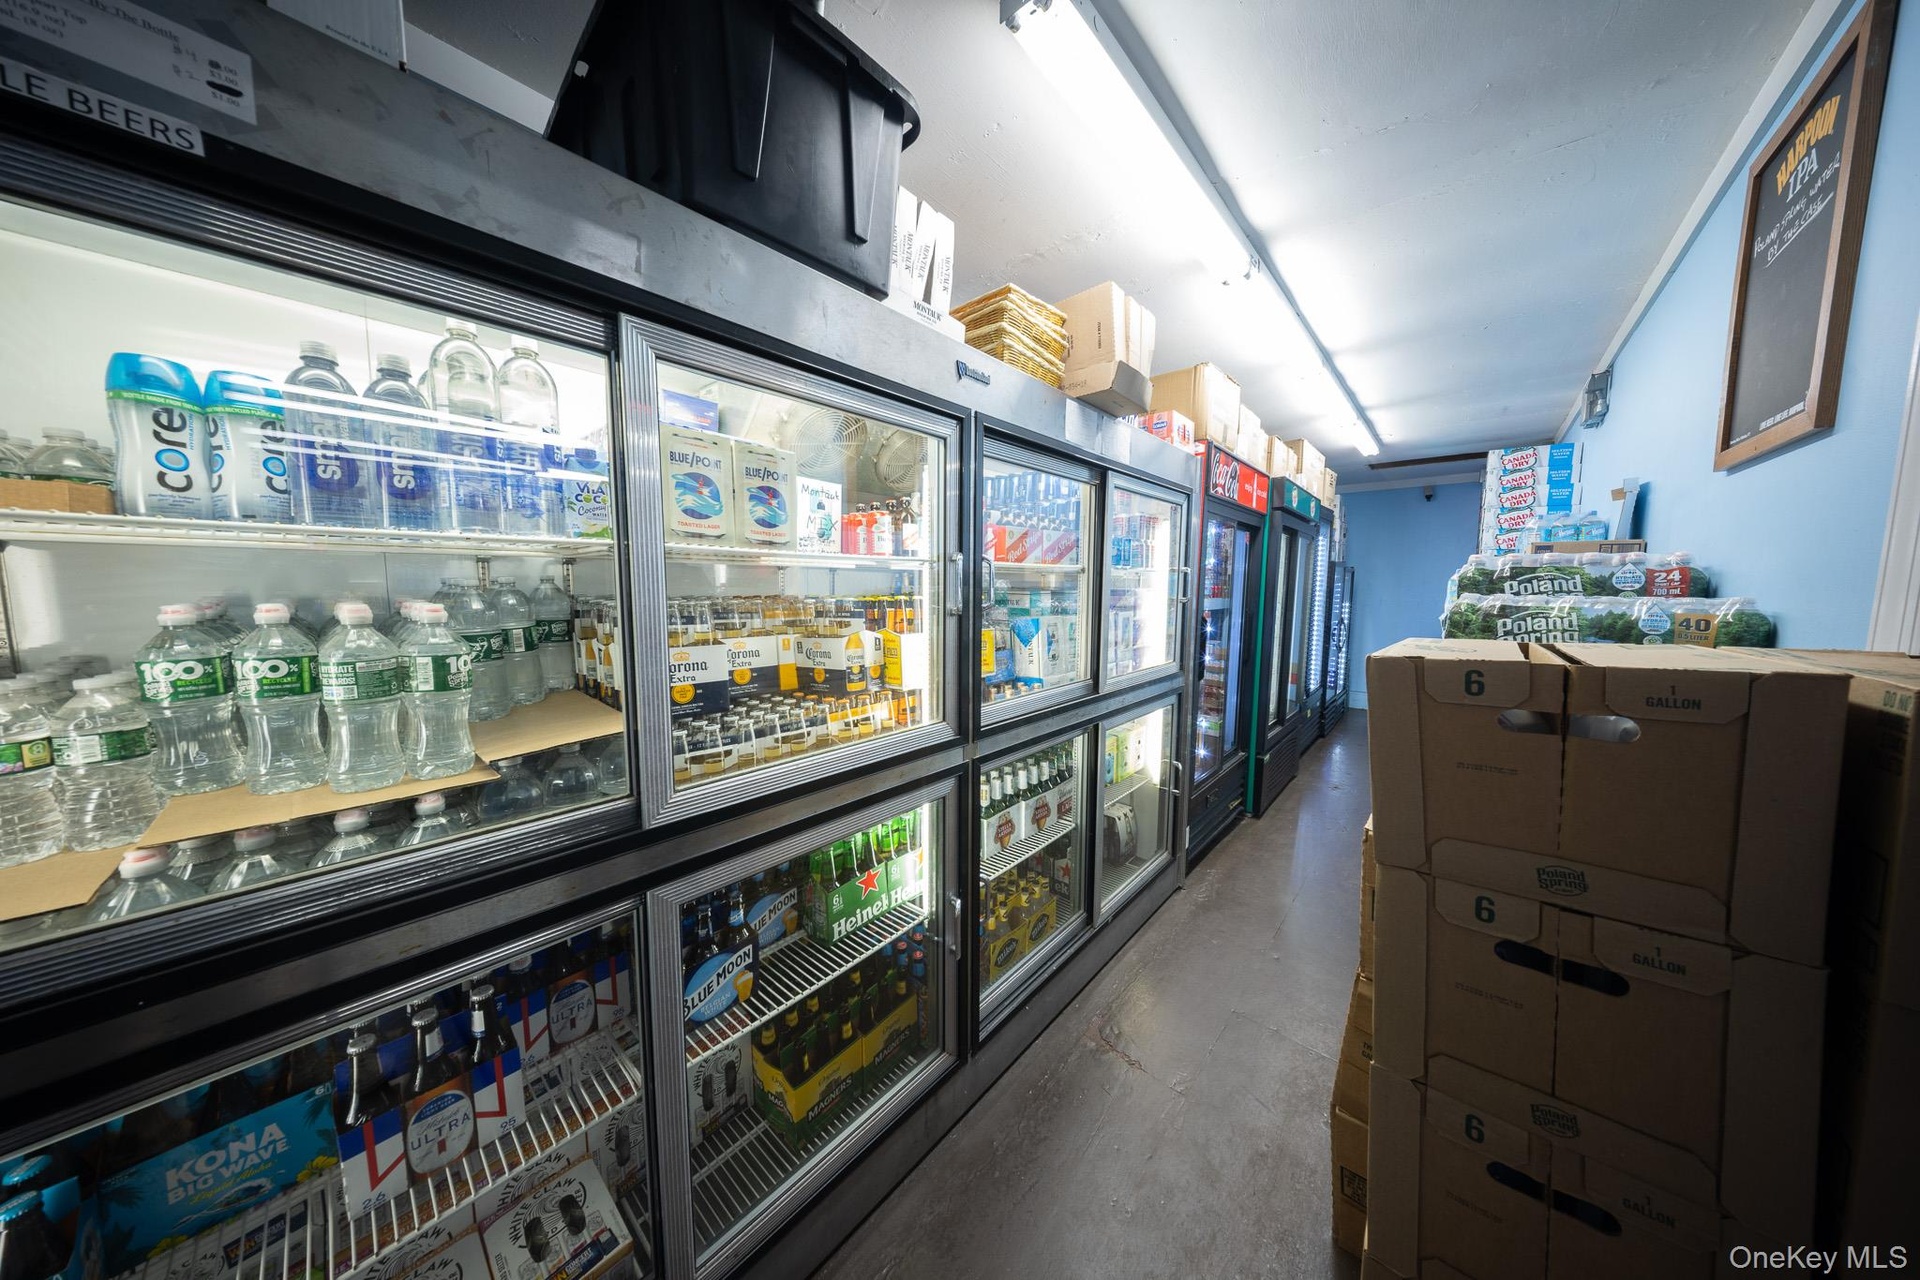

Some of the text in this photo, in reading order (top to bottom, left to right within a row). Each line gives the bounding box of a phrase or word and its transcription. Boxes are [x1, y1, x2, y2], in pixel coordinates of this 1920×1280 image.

[67, 87, 195, 151] BEERS
[1776, 95, 1841, 196] HARPOON
[1786, 148, 1818, 203] IPA
[1800, 194, 1824, 226] CASE
[152, 407, 194, 493] core
[1501, 452, 1538, 466] CANADA
[1512, 460, 1529, 469] DRY
[1500, 472, 1536, 486] CANADA
[800, 483, 841, 501] Montauk
[1499, 490, 1536, 504] CANADA
[1509, 498, 1528, 507] DRY
[677, 521, 702, 529] TOASTED
[1497, 512, 1535, 525] CANADA
[1508, 519, 1527, 528] DRY
[1503, 574, 1584, 596] Poland
[1653, 570, 1682, 583] 24
[1497, 612, 1580, 637] Poland
[1678, 617, 1712, 633] 40
[731, 659, 752, 668] Extra
[805, 647, 832, 660] Corona
[812, 658, 826, 667] Extra
[669, 660, 708, 673] orona
[670, 674, 696, 684] Extra
[1463, 669, 1486, 697] 6
[1669, 684, 1677, 695] 1
[1645, 695, 1701, 711] GALLON
[1535, 866, 1586, 884] Poland
[1537, 875, 1589, 894] Spring
[768, 891, 796, 921] MOON
[832, 893, 840, 905] 6
[1474, 895, 1496, 923] 6
[1655, 946, 1662, 957] 1
[716, 948, 751, 988] MOON
[1632, 953, 1687, 977] GALLON
[552, 998, 593, 1025] ULTRA
[874, 1028, 911, 1066] MAGNERS
[692, 1057, 711, 1092] WHITE
[315, 1085, 324, 1095] 6
[807, 1077, 853, 1121] MAGNERS
[500, 1115, 517, 1130] 95
[1530, 1104, 1578, 1126] Poland
[410, 1113, 471, 1151] ULTRA
[604, 1108, 625, 1145] WHITE
[1463, 1113, 1486, 1144] 6
[1531, 1115, 1581, 1138] Spring
[165, 1122, 287, 1191] KONA
[168, 1138, 290, 1205] BIG WAVE
[362, 1190, 386, 1211] 2.6
[509, 1177, 577, 1245] WHITE CLAW
[1621, 1198, 1676, 1230] GALLON
[564, 1246, 593, 1272] CONCERT
